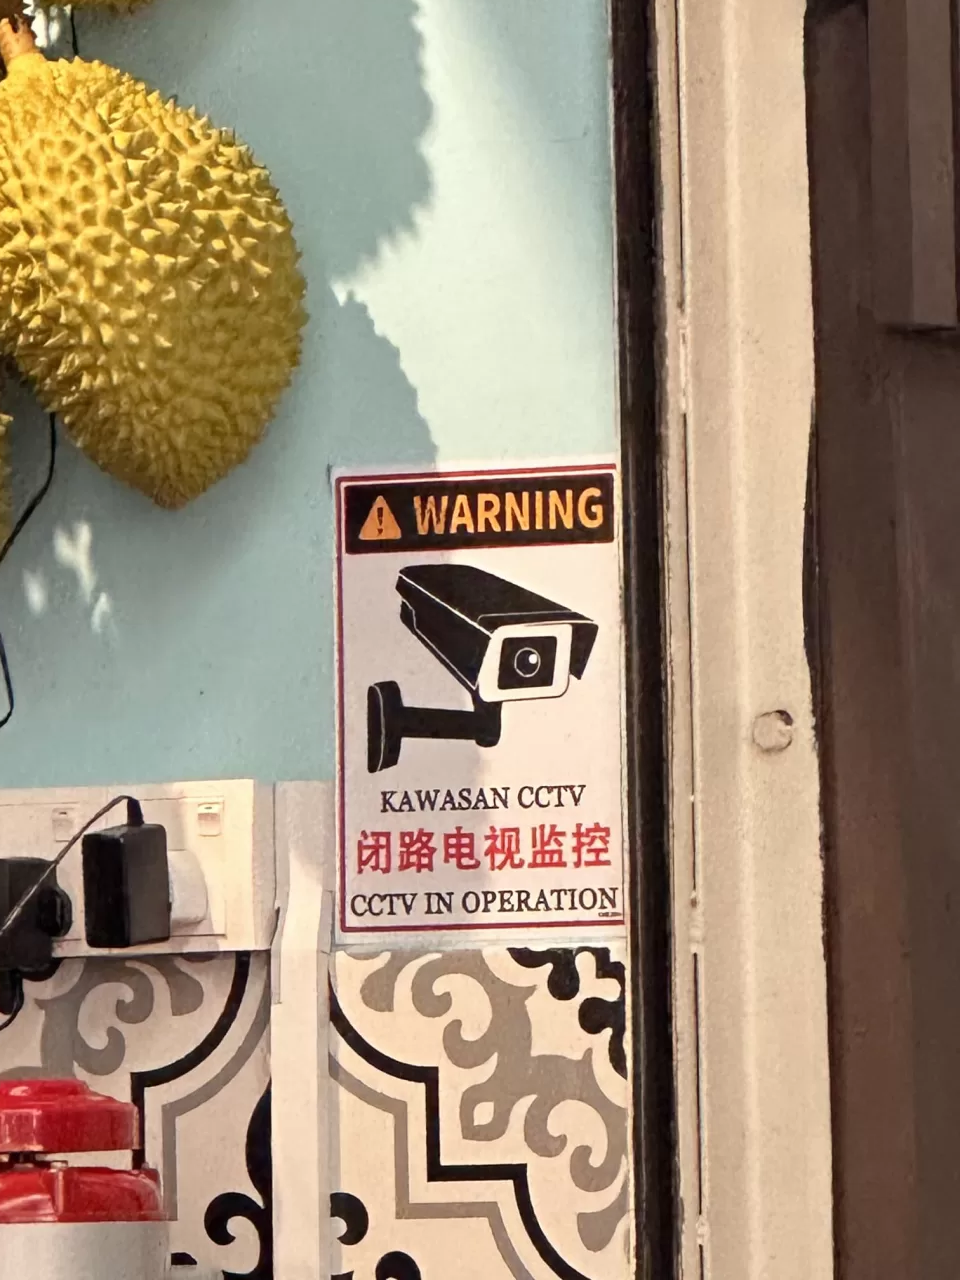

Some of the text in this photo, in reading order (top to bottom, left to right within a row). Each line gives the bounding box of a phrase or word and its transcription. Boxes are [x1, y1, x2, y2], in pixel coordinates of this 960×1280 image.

[413, 487, 604, 535] WARNING
[380, 785, 586, 813] KAWASAN CCTV
[357, 822, 612, 874] 闭路电视监控
[350, 887, 619, 916] CCTV IN OPERATION
